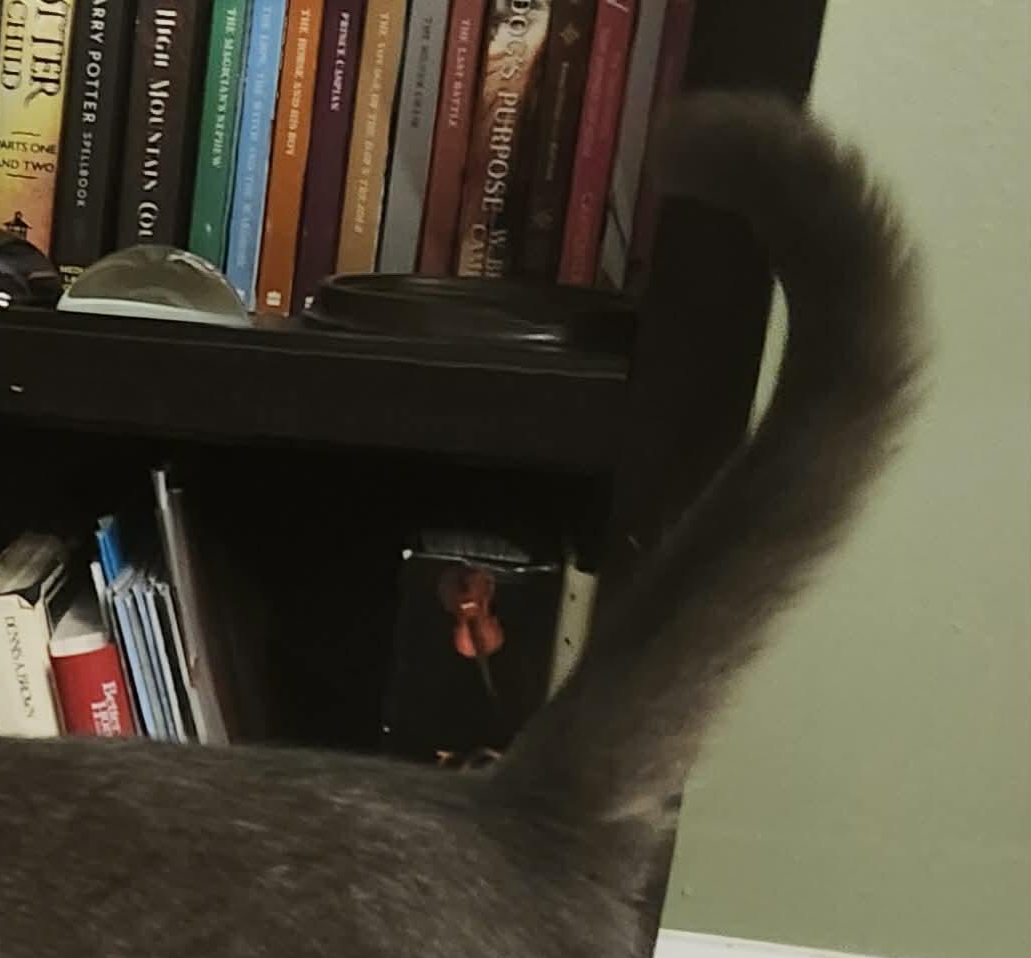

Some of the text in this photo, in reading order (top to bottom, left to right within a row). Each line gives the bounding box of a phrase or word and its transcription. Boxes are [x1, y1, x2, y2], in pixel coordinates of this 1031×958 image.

[1, 1, 27, 90] CHILD
[153, 9, 177, 67] HIGH
[225, 8, 237, 33] THE
[298, 8, 311, 34] THE
[377, 13, 390, 36] THE
[295, 37, 308, 79] HORSE
[329, 12, 349, 112] PRINCE CASPIAN
[448, 19, 470, 127] THE LAST BATTLE
[82, 51, 102, 123] POTTER
[291, 80, 303, 108] AND
[29, 143, 57, 155] ONE
[142, 80, 170, 190] MOUNTAIN
[211, 114, 226, 169] NEPHEW
[285, 131, 298, 156] BOY
[481, 91, 518, 213] PURPOSE
[24, 160, 55, 174] TWO
[76, 132, 93, 207] SPELLBOOK
